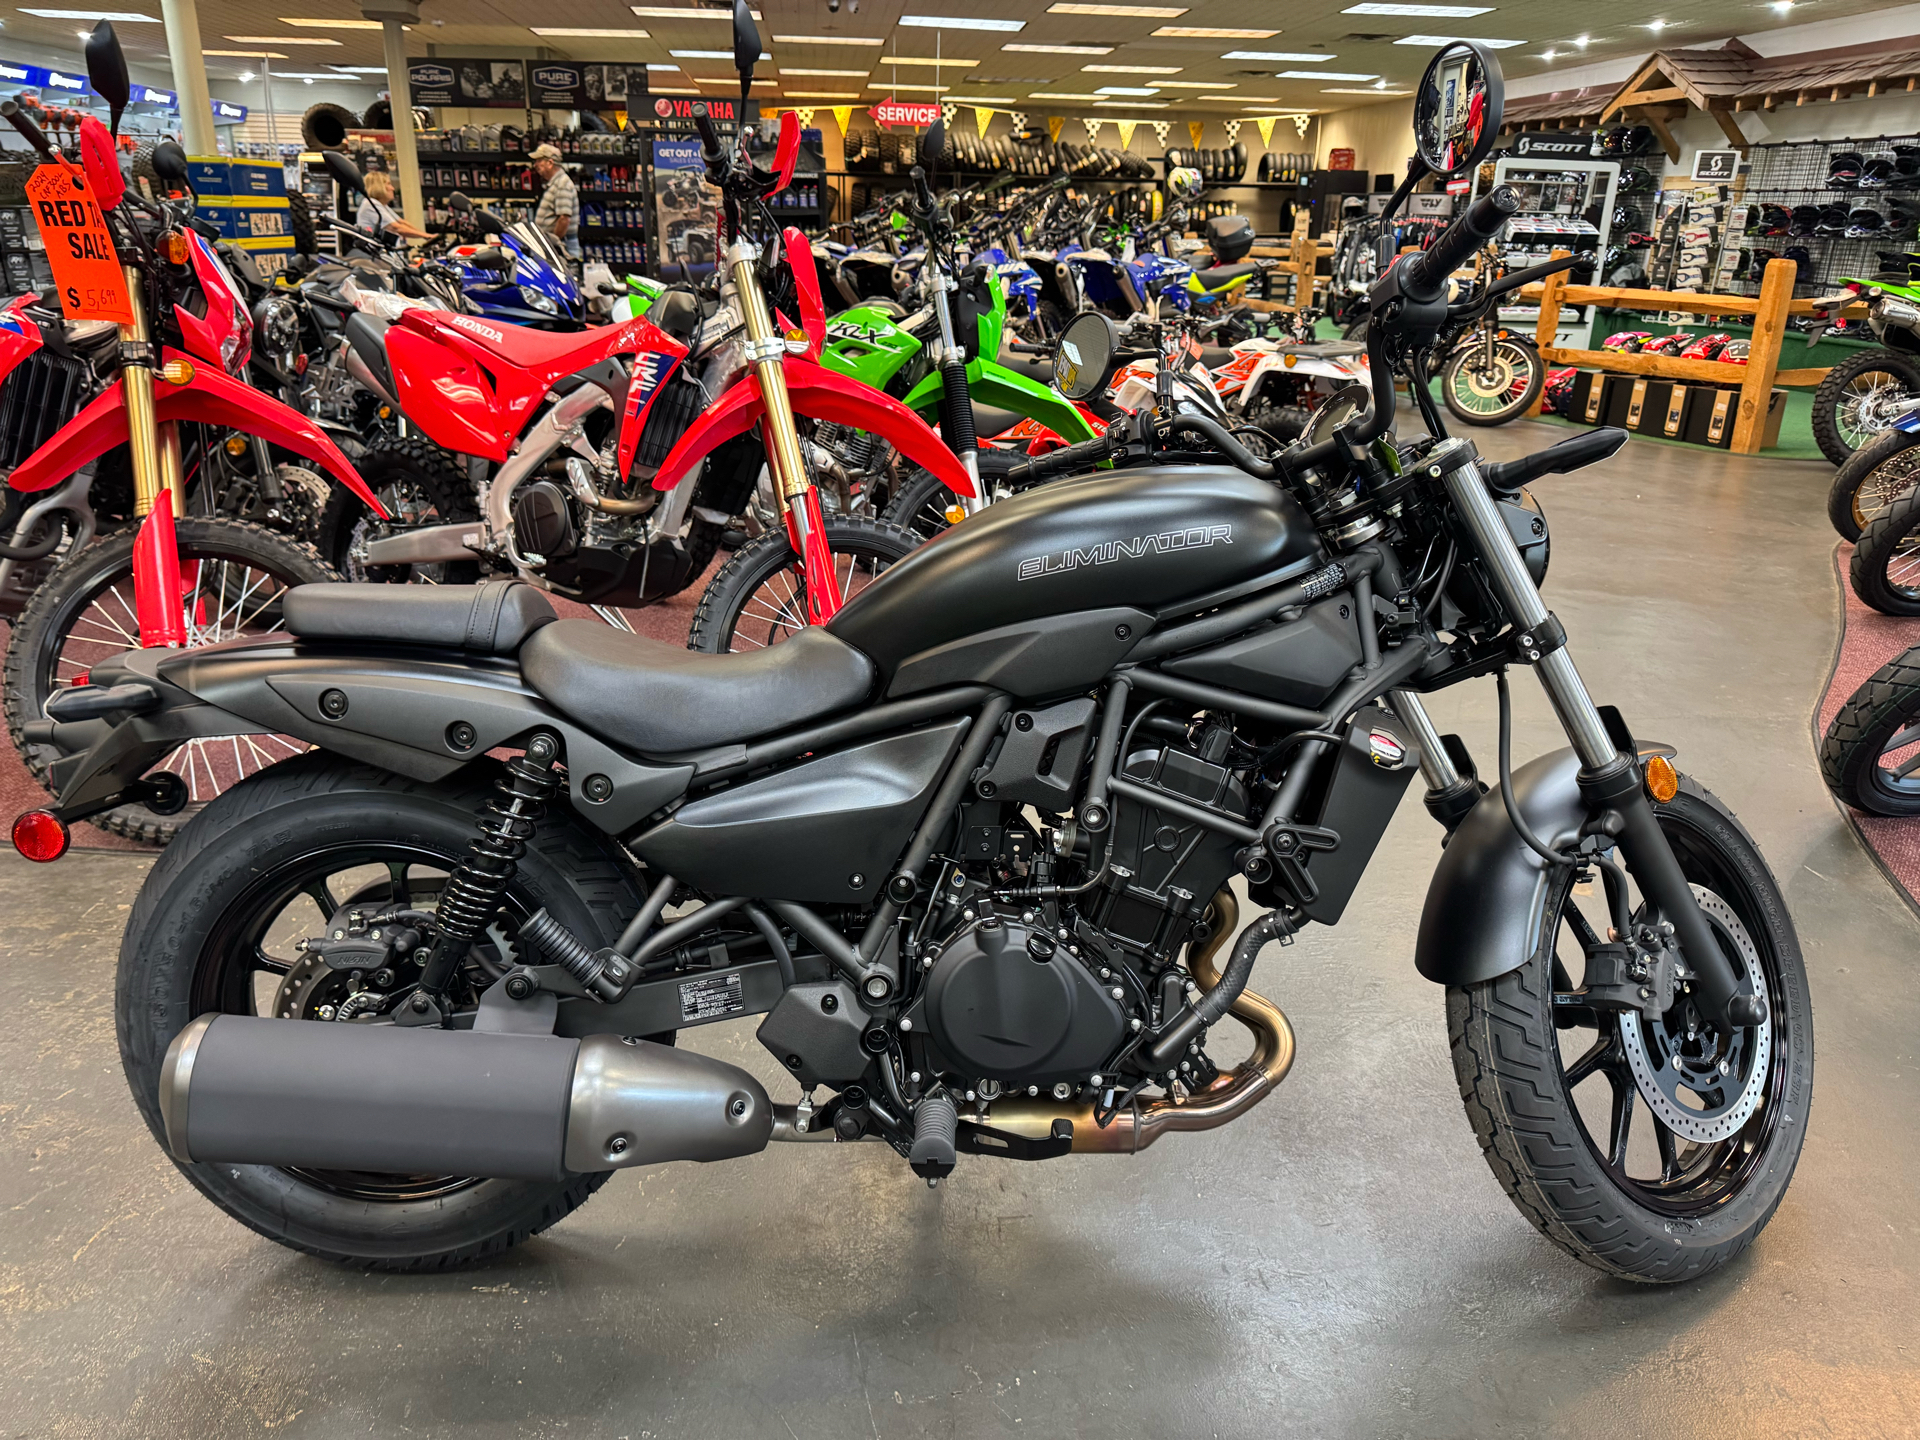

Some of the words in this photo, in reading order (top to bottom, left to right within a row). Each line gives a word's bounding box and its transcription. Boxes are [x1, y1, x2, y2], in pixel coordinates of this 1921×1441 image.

[538, 72, 573, 81] PURE
[673, 100, 735, 119] YAAHA
[877, 106, 937, 123] SERVICE
[658, 149, 675, 158] GET
[675, 149, 693, 158] OUT
[1530, 142, 1586, 152] SCOTT
[37, 200, 86, 227] RED
[87, 201, 106, 230] TA
[67, 232, 111, 261] SALE
[66, 286, 82, 310] $
[451, 316, 504, 344] HONDA
[829, 321, 888, 346] KLX
[628, 351, 662, 394] CRF
[1017, 524, 1234, 582] ELIMINATOR
